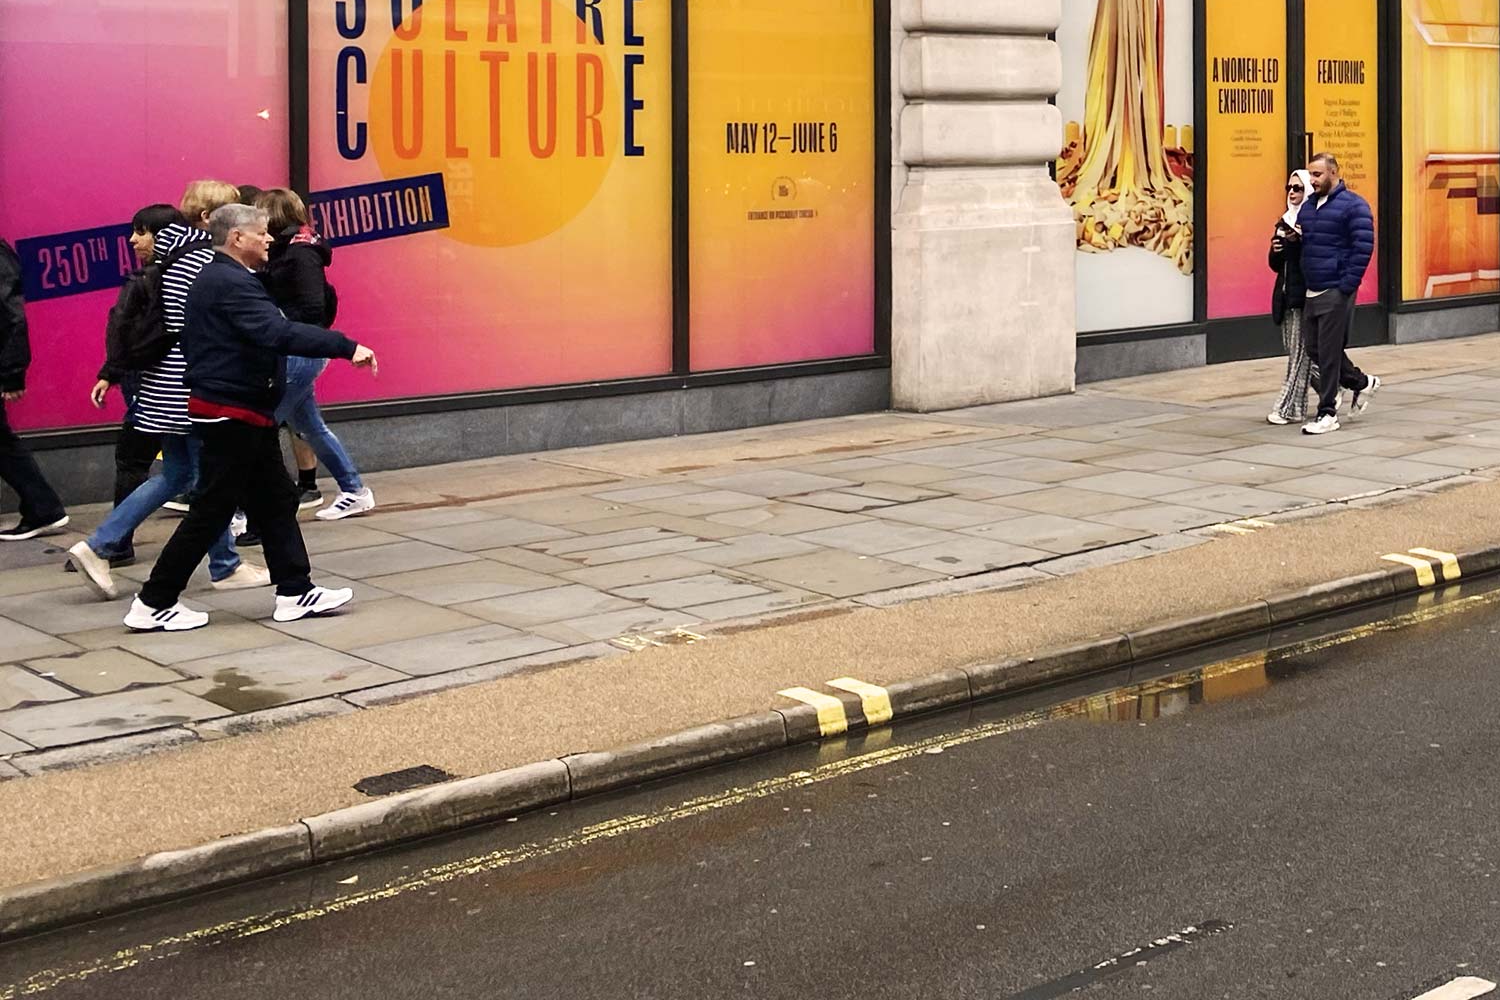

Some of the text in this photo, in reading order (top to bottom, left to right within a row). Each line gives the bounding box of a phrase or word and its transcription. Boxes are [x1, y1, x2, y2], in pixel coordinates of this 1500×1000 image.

[1212, 57, 1279, 83] A WOMEN-LED
[1317, 59, 1365, 85] FEATURING
[336, 45, 645, 160] CULTURE
[1218, 88, 1274, 114] EXHIBITION
[726, 122, 758, 154] MAY
[829, 122, 838, 152] 6
